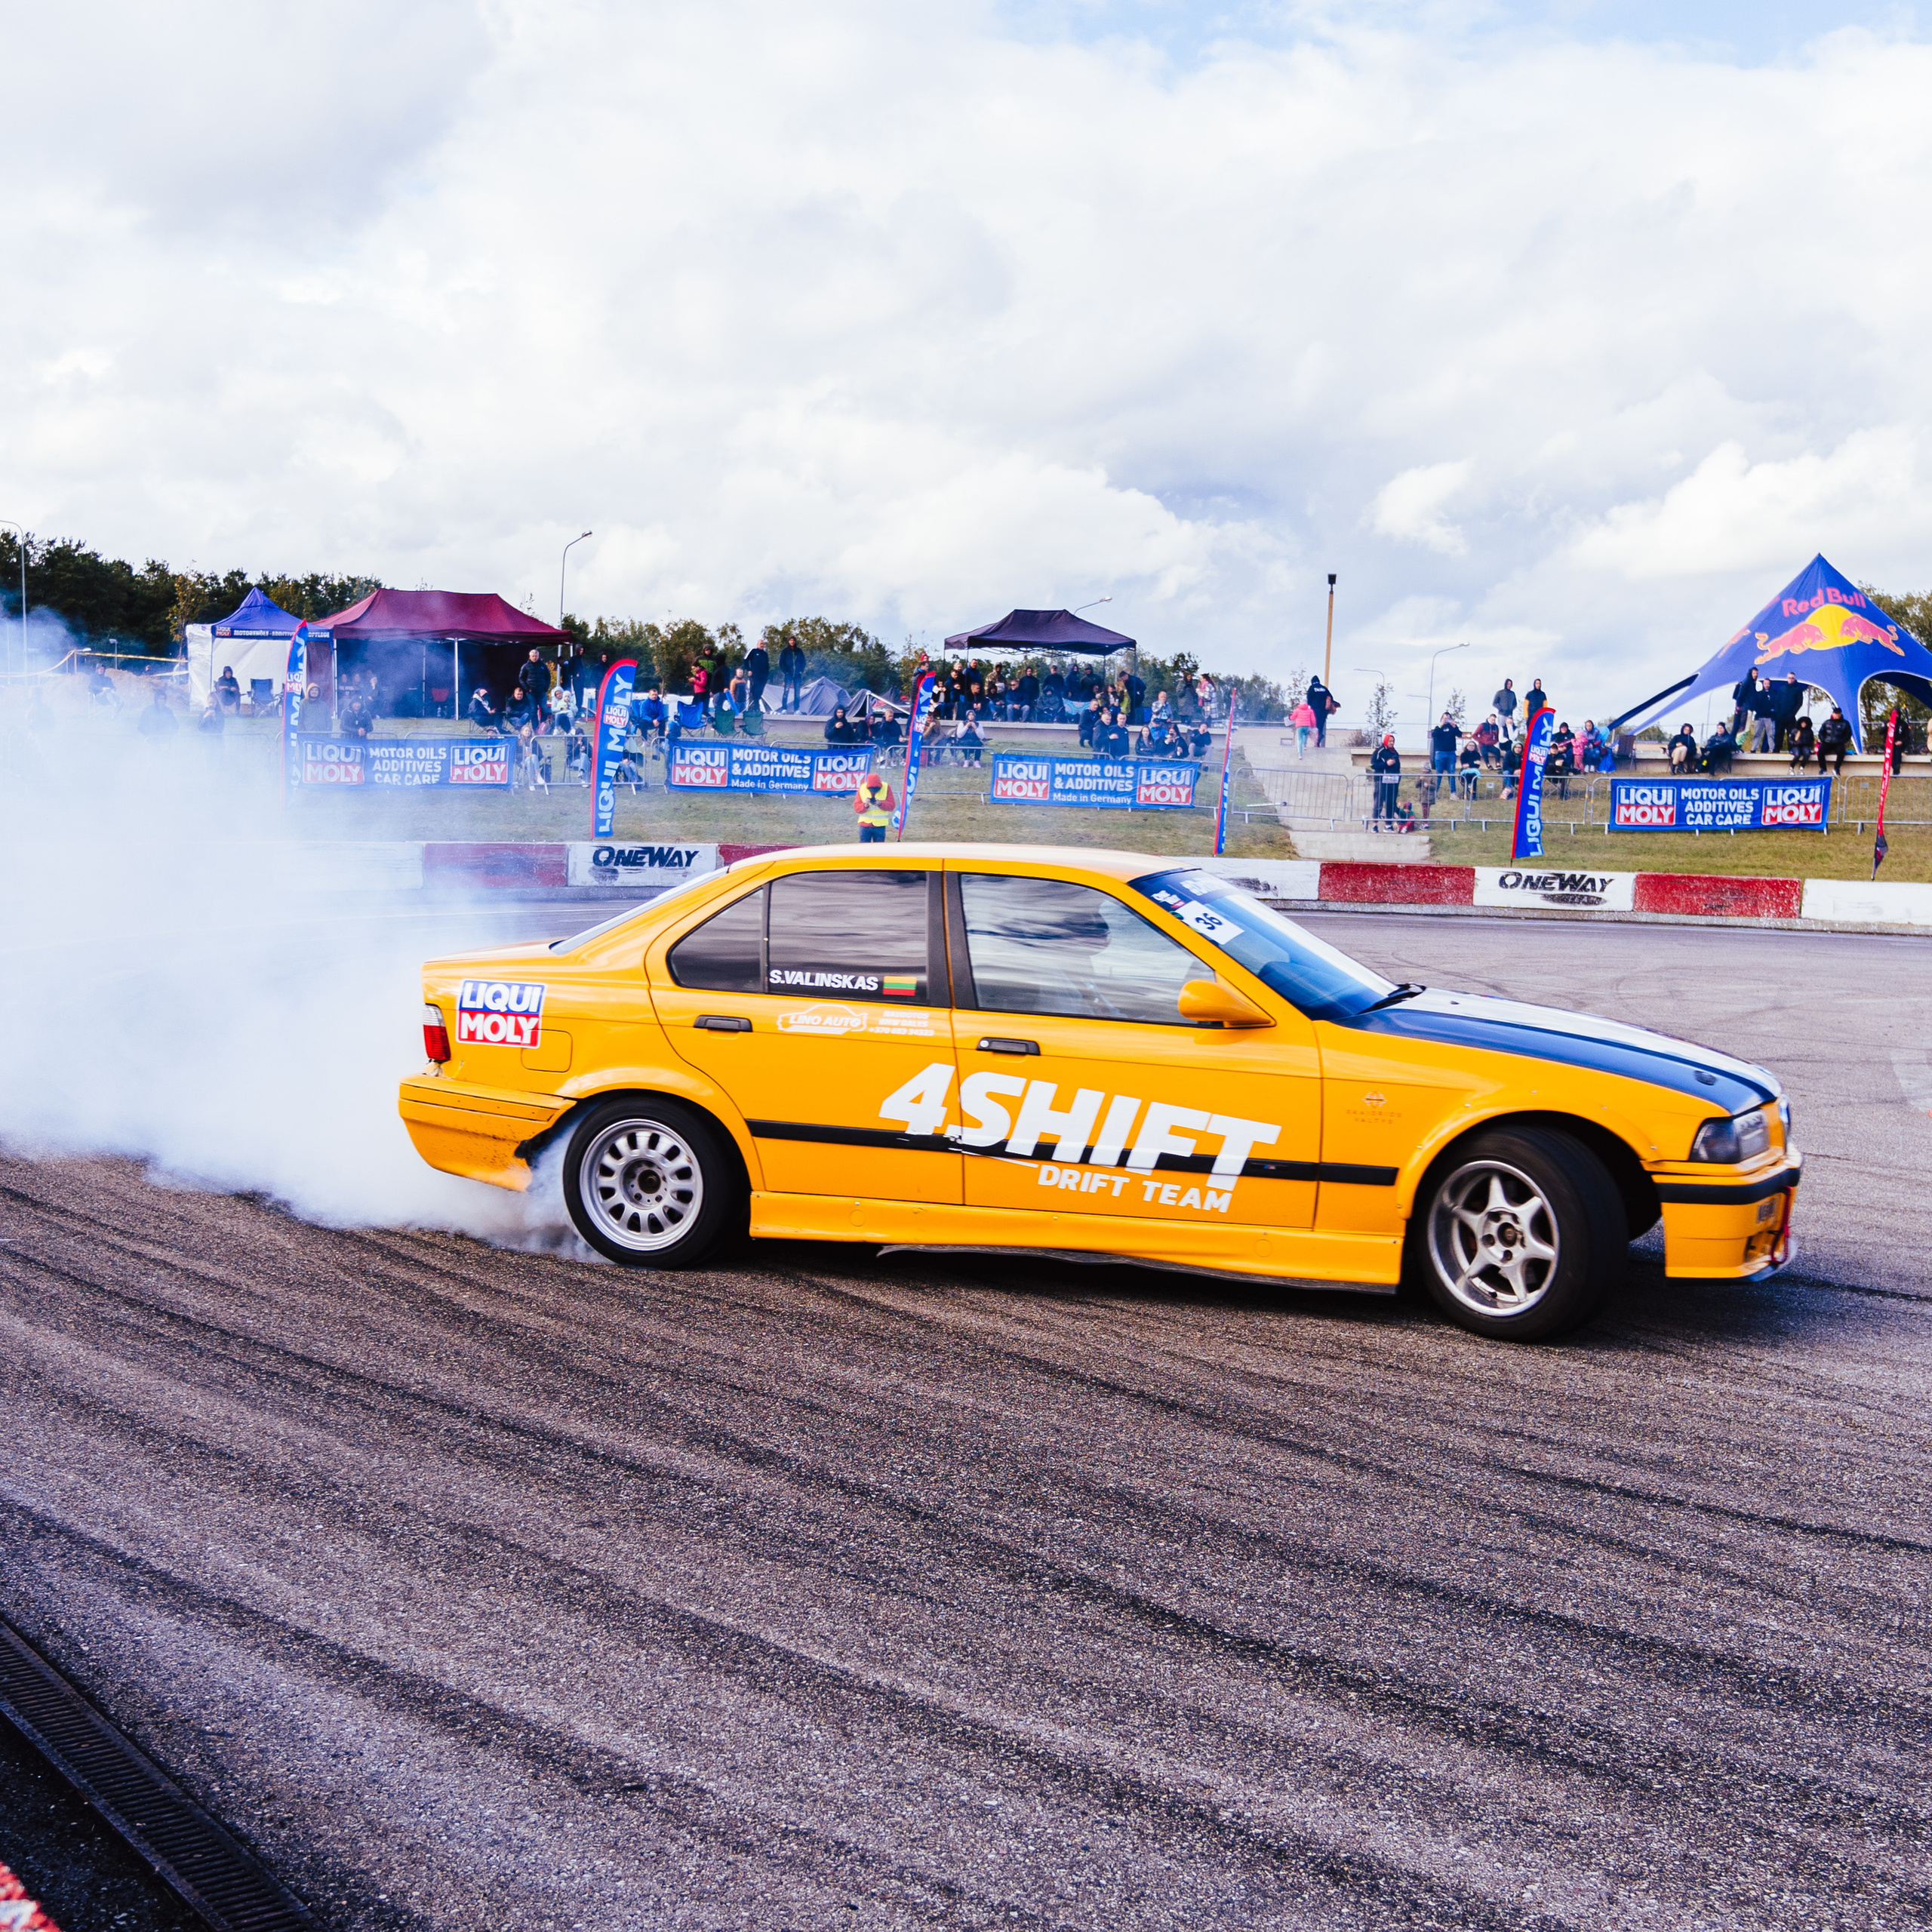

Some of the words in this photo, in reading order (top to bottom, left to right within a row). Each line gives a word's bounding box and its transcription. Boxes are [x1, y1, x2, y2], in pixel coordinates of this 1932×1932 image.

[1782, 589, 1824, 617] Red
[1826, 586, 1867, 610] Bull
[605, 714, 626, 726] MOLY
[606, 706, 626, 717] LIQUI
[607, 672, 632, 752] MLY
[306, 744, 361, 762] LIQUI
[370, 747, 414, 760] MOTOR
[417, 747, 447, 760] OILS
[454, 746, 506, 765] LIQUI
[676, 749, 725, 767] LIQUI
[732, 749, 778, 763] MOTOR
[780, 753, 811, 764] OILS
[1531, 744, 1546, 757] LIQUI
[372, 760, 441, 773] ADDITIVES
[454, 764, 506, 781] MOLY
[743, 764, 811, 778] ADDITIVES
[818, 756, 866, 772] LIQUI
[998, 763, 1048, 780] LIQUI
[1055, 763, 1100, 777] MOTOR
[1103, 765, 1134, 778] OILS
[306, 764, 361, 782] MOLY
[374, 773, 401, 786] CAR
[404, 774, 440, 786] CARE
[675, 767, 727, 785] MOLY
[817, 772, 866, 790] MOLY
[1141, 769, 1190, 786] LIQUI
[731, 779, 755, 788] Made
[758, 780, 766, 789] in
[768, 780, 809, 791] Germany
[997, 780, 1048, 798] MOLY
[1065, 778, 1133, 792] ADDITIVES
[1053, 792, 1078, 802] Made
[1079, 792, 1088, 802] in
[1091, 794, 1132, 804] Germany
[1140, 786, 1191, 803] MOLY
[1620, 788, 1672, 806] LIQUI
[1681, 788, 1727, 800] MOTOR
[1729, 788, 1759, 801] OILS
[1767, 786, 1820, 805] LIQUI
[1619, 806, 1674, 823] MOLY
[1684, 801, 1754, 814] ADDITIVES
[1764, 804, 1822, 823] MOLY
[1526, 794, 1544, 857] LIQUI
[1686, 814, 1713, 825] CAR
[1715, 814, 1751, 826] CARE
[1195, 912, 1223, 931] 36
[769, 969, 879, 991] S.VALINSKAS
[461, 982, 542, 1012] LIQUI
[460, 1013, 540, 1044] MOLY
[789, 1014, 821, 1026] LINO
[822, 1017, 861, 1028] AUTO
[878, 1063, 1281, 1191] 4SHIFT
[1038, 1164, 1130, 1196] DRIFT
[1142, 1180, 1232, 1213] TEAM
